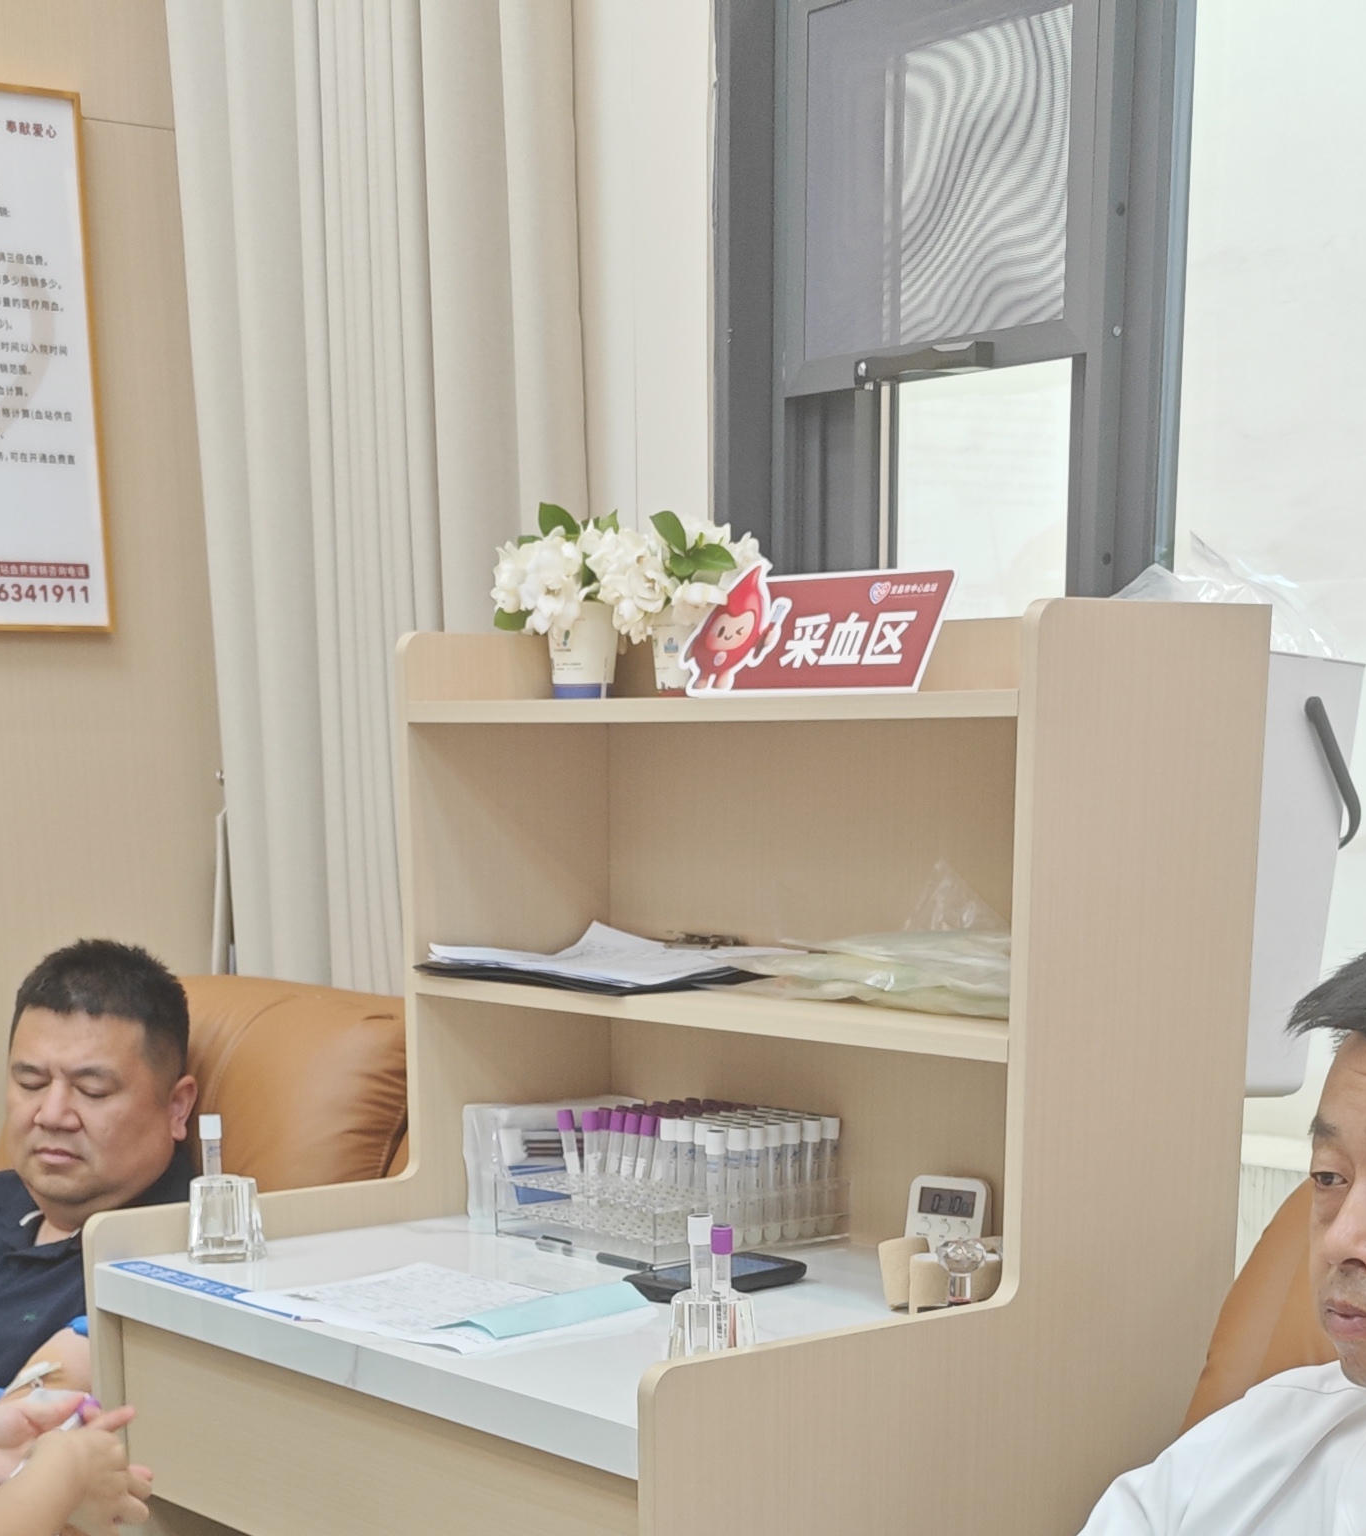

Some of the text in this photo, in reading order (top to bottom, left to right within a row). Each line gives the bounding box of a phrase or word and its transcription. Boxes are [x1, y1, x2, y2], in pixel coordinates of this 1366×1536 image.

[6, 120, 57, 139] 奉献爱心
[779, 610, 918, 669] 采血区
